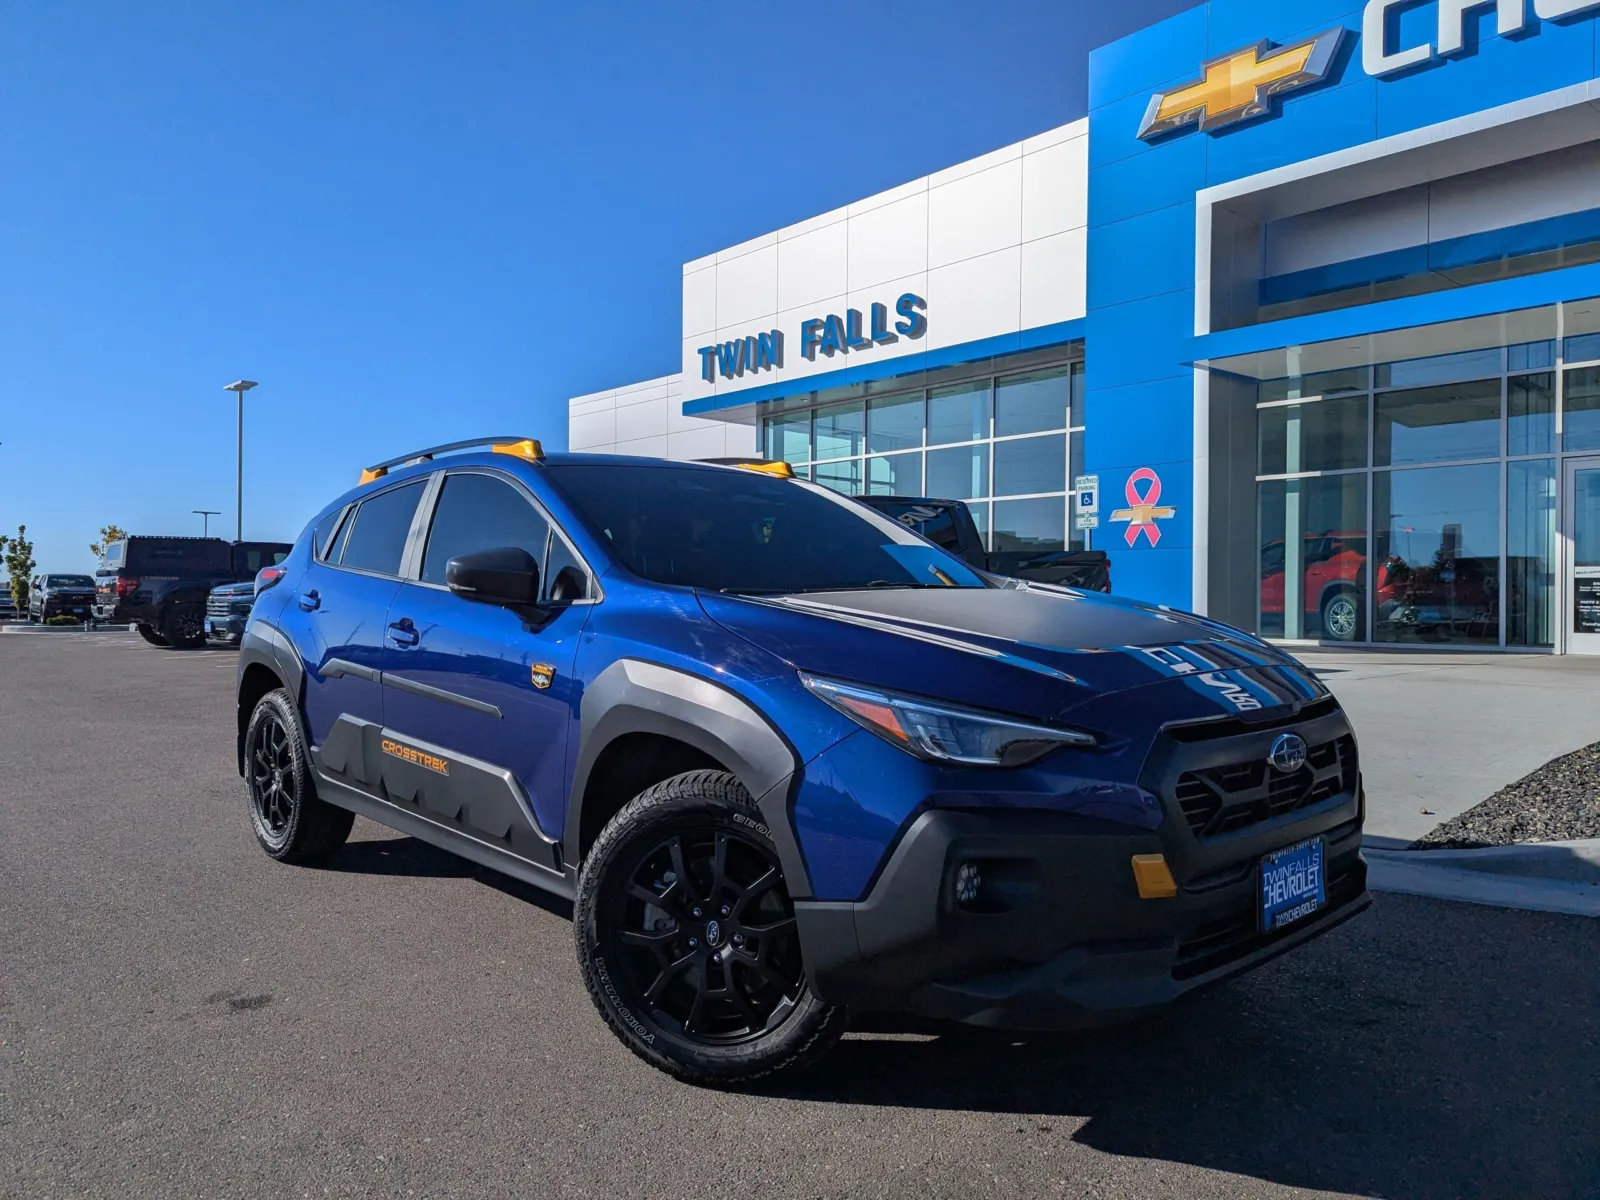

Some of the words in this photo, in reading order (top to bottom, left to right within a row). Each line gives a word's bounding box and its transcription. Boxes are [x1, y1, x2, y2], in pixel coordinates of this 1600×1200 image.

[697, 329, 784, 384] TWIN
[801, 292, 927, 363] FALLS
[382, 740, 448, 774] CROSSTREK
[1288, 898, 1318, 922] CHEVROLET
[595, 957, 655, 1044] YOKOHAMA
